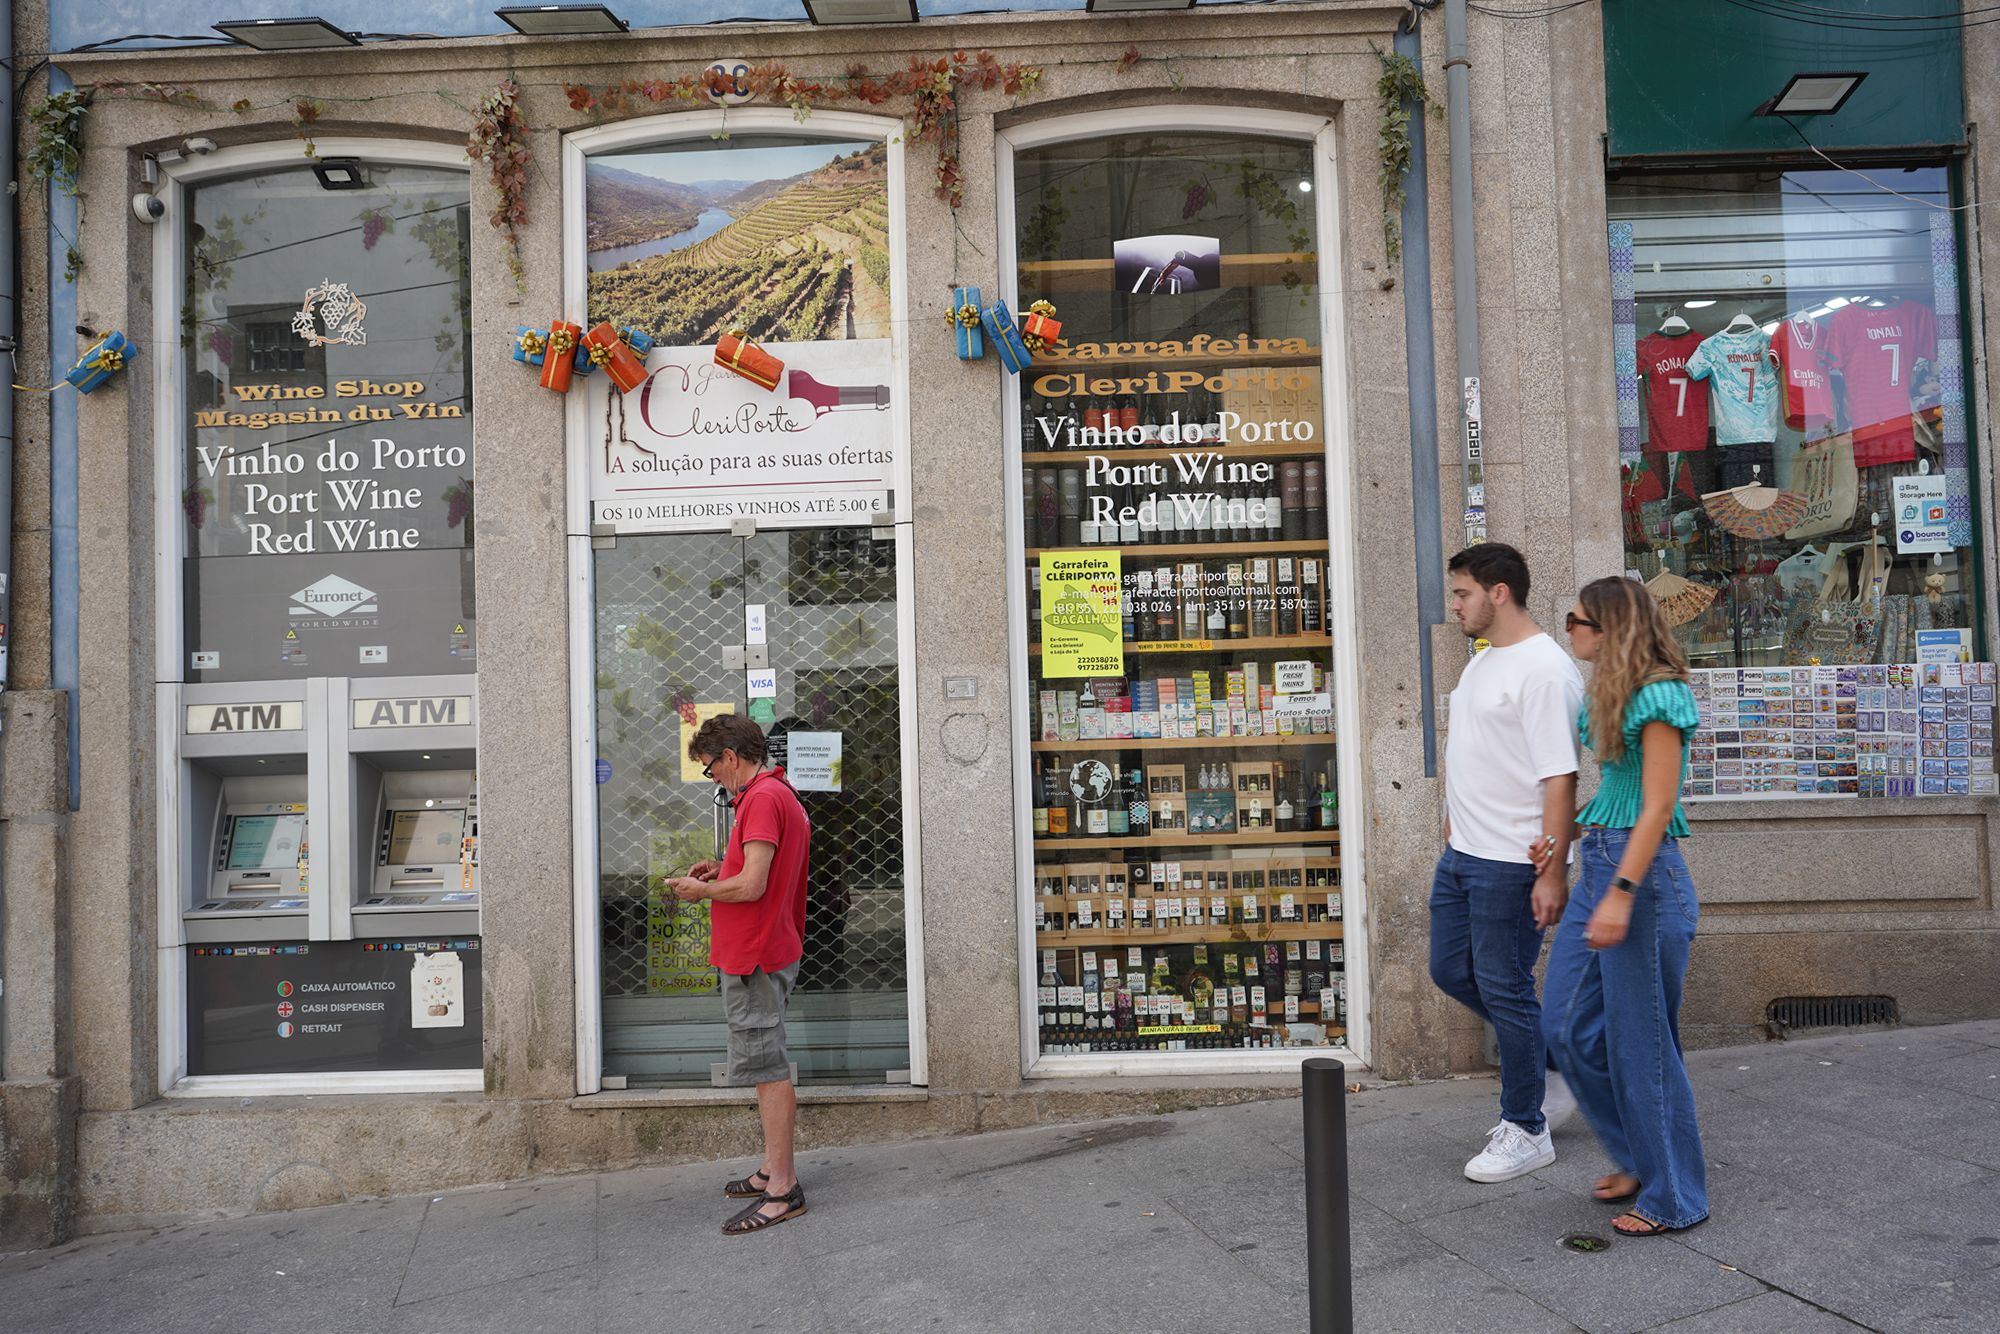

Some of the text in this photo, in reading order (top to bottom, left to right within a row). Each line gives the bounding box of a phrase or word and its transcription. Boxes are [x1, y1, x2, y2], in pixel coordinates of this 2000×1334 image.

[1033, 333, 1312, 361] Garrafeira
[1881, 344, 1900, 386] 7
[233, 380, 425, 401] Wine Shop
[1033, 371, 1311, 397] CleriPorto
[1741, 367, 1755, 402] 7
[1669, 378, 1688, 417] 7
[195, 402, 463, 429] Magasin du Vin
[1035, 412, 1147, 448] Vinho
[1160, 411, 1204, 445] do
[1216, 411, 1314, 443] Porto
[196, 438, 466, 477] Vinho do Porto
[611, 446, 893, 476] A solução para as suas ofertas
[1085, 452, 1270, 486] Port Wine
[244, 479, 422, 516] Port Wine
[602, 497, 880, 520] OS 10 MELHORES VINHOS ATÉ 5.00 €
[1090, 492, 1268, 528] Red Wine
[248, 519, 420, 555] Red Wine
[1046, 570, 1116, 581] CLÉRIPORTO
[1053, 559, 1108, 569] Garrafeira
[304, 589, 364, 604] Euronet
[1127, 601, 1147, 613] 038
[1151, 601, 1172, 612] 026
[1214, 600, 1234, 610] 351
[1238, 600, 1251, 610] 91
[1256, 599, 1277, 610] 722
[1281, 598, 1308, 610] 5870
[289, 618, 379, 629] WORLDWIDE
[1053, 613, 1118, 625] BACALHAU
[751, 679, 773, 689] VISA
[1714, 672, 1735, 680] PORTO
[1714, 687, 1735, 695] PORTO
[210, 704, 281, 732] ATM
[369, 699, 456, 726] ATM
[1305, 708, 1331, 716] Secos
[301, 980, 396, 993] CAIXA AUTOMÁTICO
[301, 1002, 385, 1013] CASH DISPENSER
[301, 1024, 342, 1034] RETRAIT
